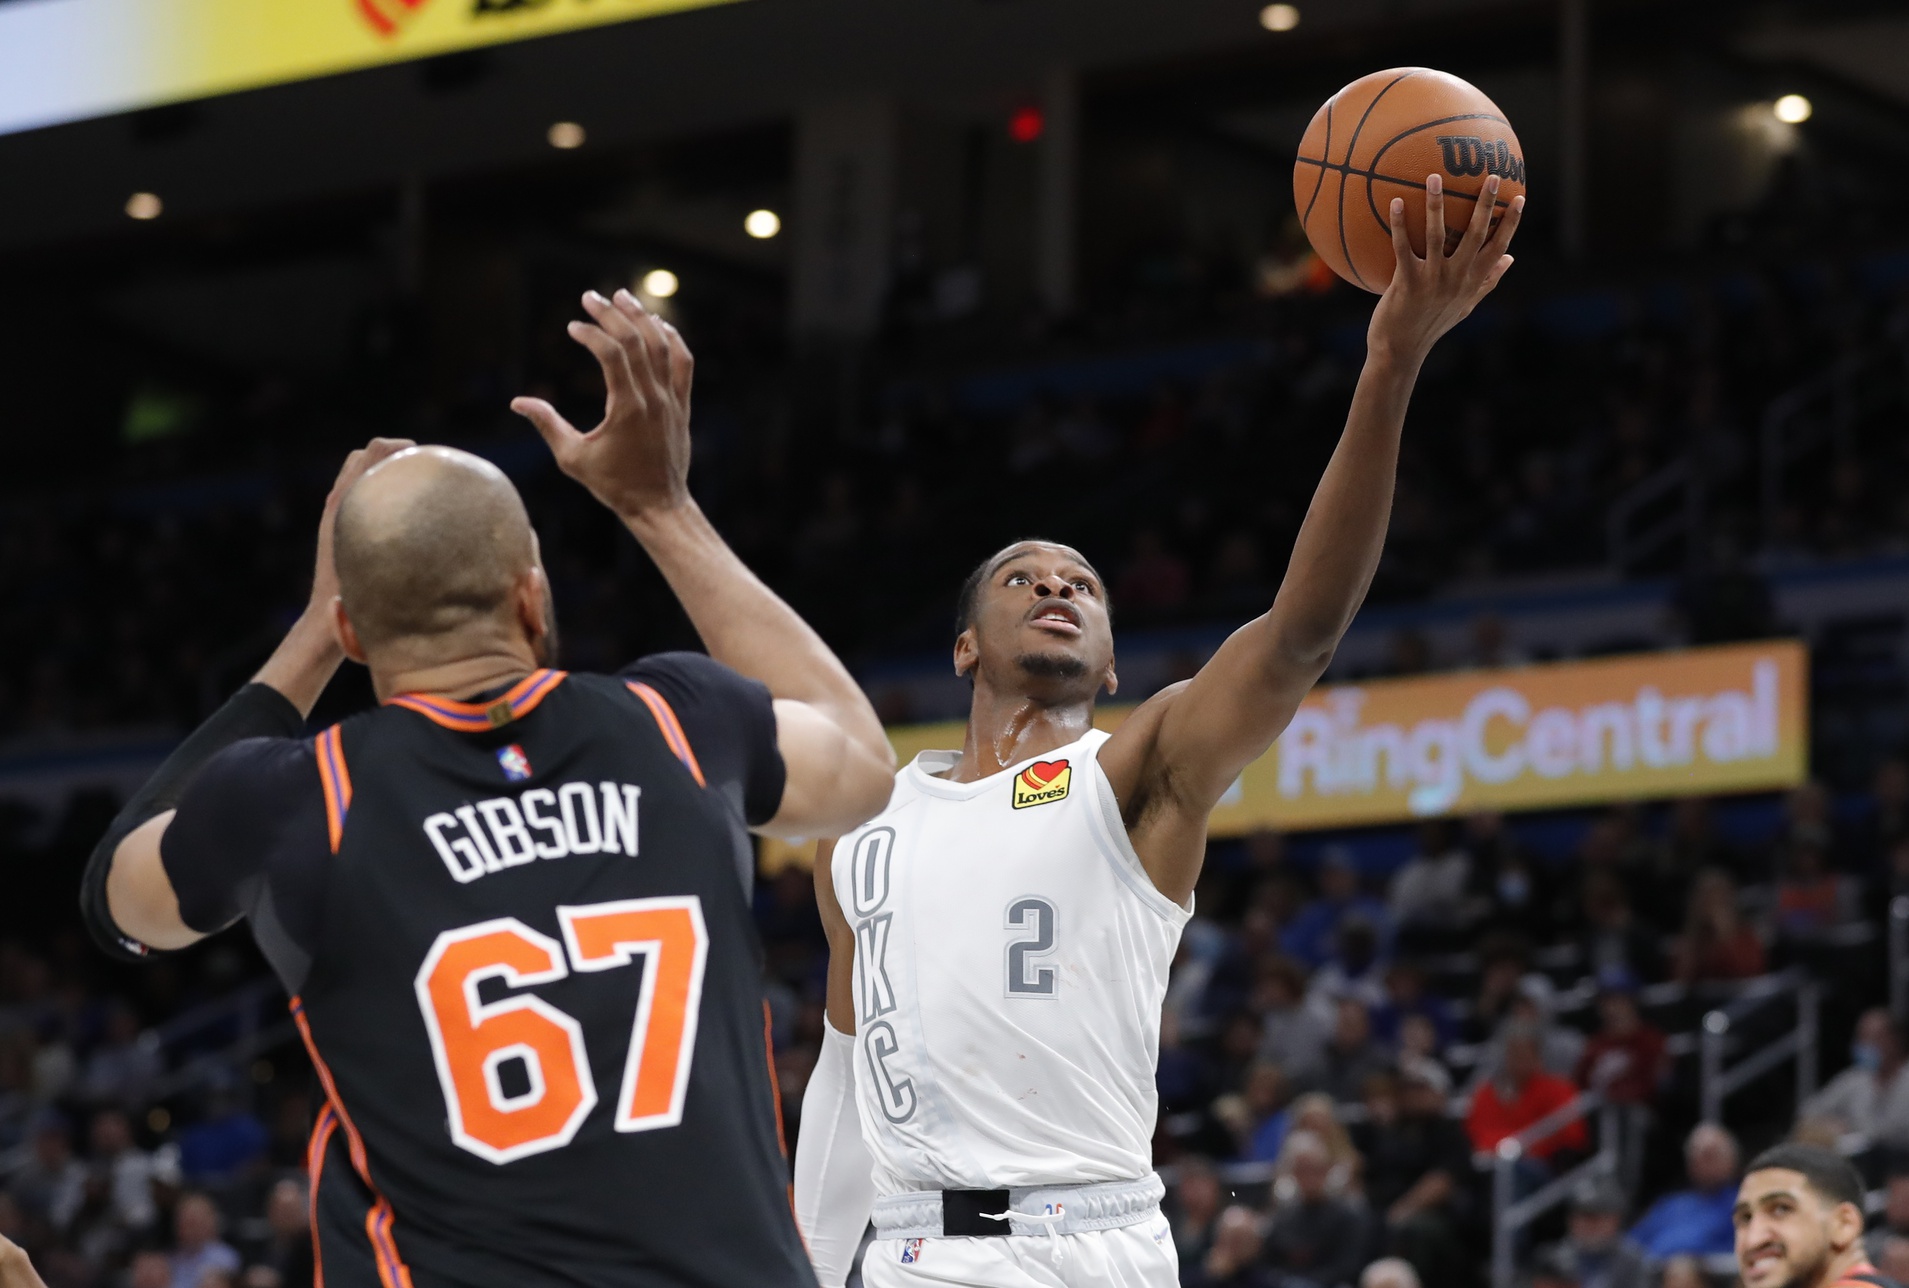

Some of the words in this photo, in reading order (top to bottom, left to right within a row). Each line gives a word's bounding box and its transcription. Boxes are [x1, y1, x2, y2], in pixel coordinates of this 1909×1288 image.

[1276, 657, 1780, 818] RingCentral
[423, 781, 641, 884] GIBSON
[851, 825, 918, 1125] OKC
[1003, 894, 1060, 1000] 2
[413, 894, 709, 1166] 67
